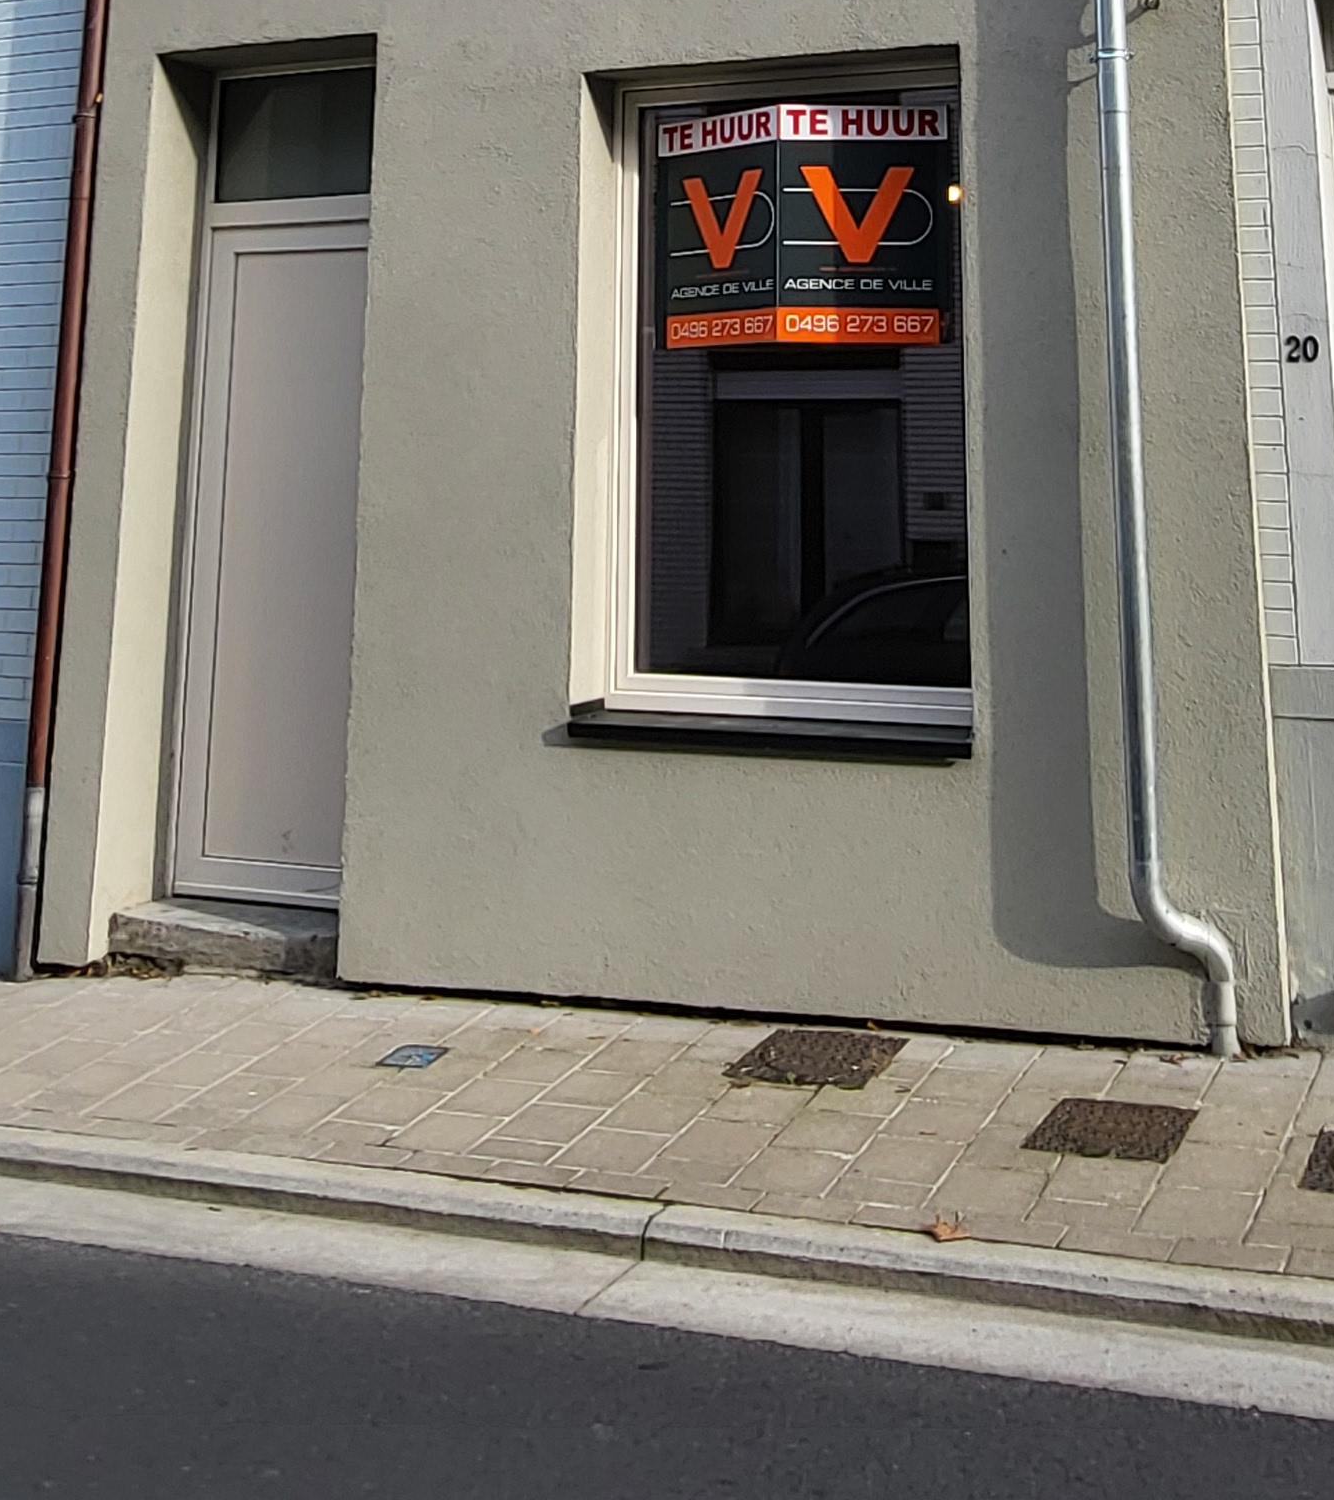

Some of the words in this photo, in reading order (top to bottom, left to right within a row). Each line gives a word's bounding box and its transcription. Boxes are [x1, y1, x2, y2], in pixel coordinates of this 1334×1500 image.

[663, 124, 693, 152] TE
[701, 111, 771, 148] HUUR
[786, 109, 828, 135] TE
[841, 109, 940, 136] HUUR
[671, 284, 720, 300] AGENCE
[722, 282, 740, 295] DE
[742, 279, 774, 292] VILLE
[784, 278, 855, 290] AGENCE
[860, 278, 883, 290] DE
[888, 279, 933, 291] VILLE
[670, 321, 708, 340] 0496
[711, 318, 740, 337] 273
[744, 315, 773, 334] 667
[785, 314, 840, 333] 0496
[846, 315, 887, 333] 273
[893, 315, 934, 333] 667
[1284, 335, 1319, 363] 20
